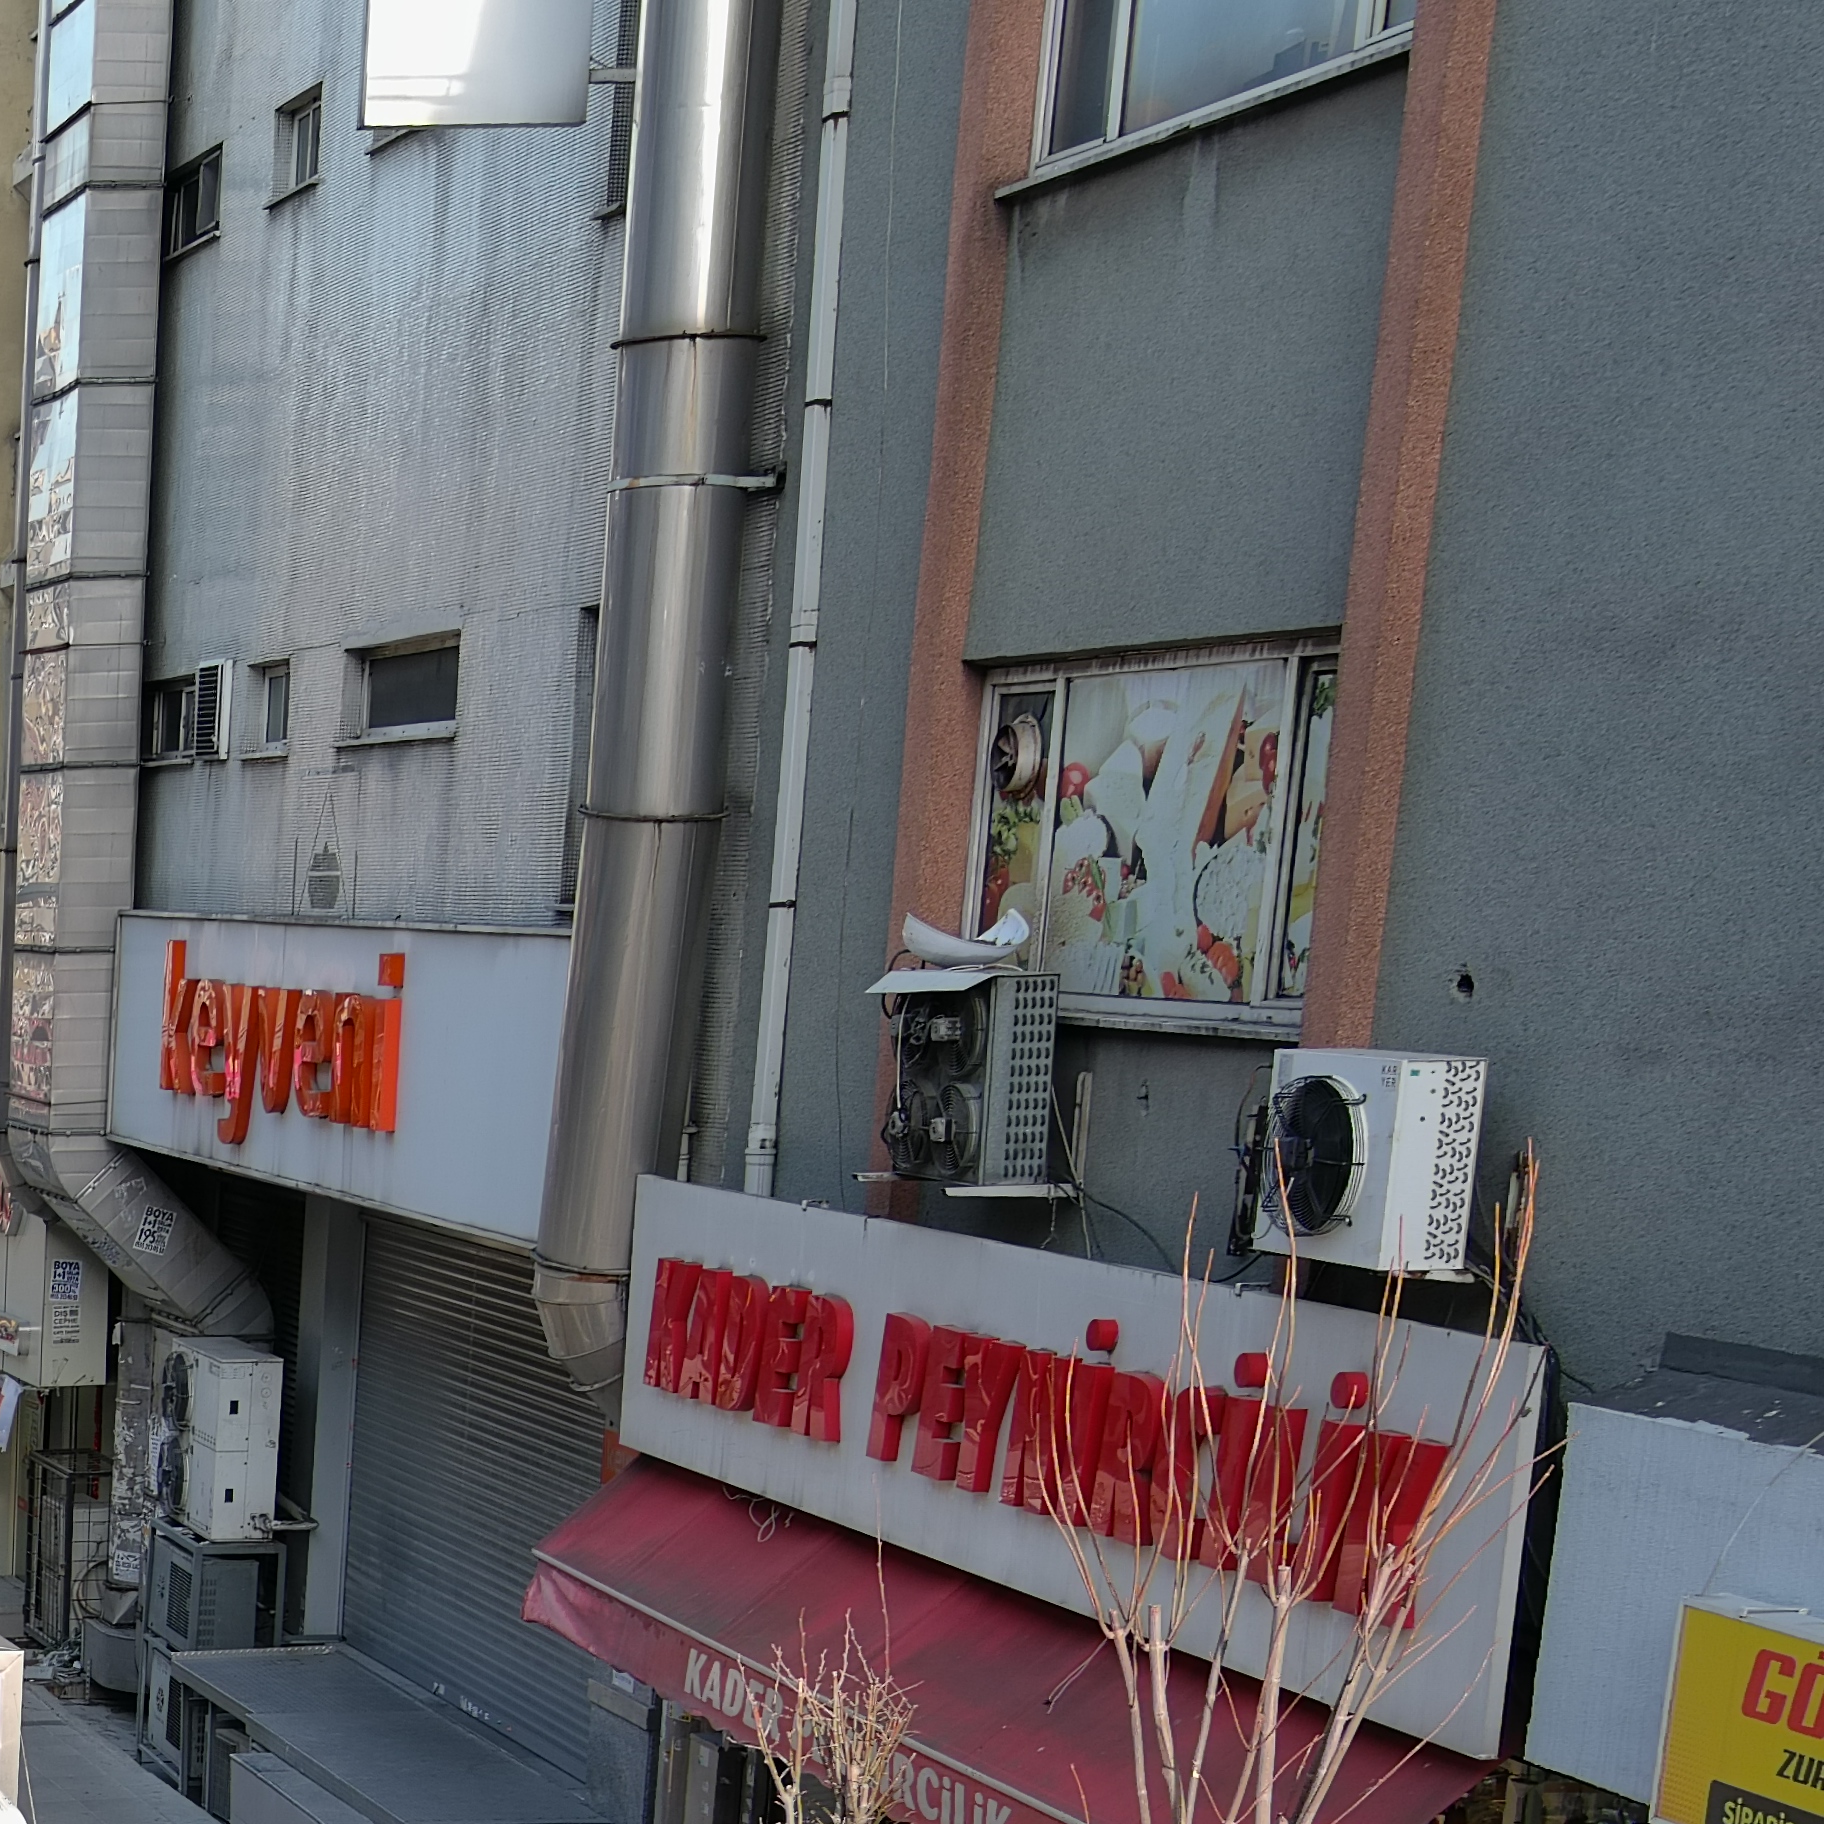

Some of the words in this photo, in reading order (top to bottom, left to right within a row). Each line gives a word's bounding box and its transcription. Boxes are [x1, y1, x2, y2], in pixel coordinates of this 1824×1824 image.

[141, 1216, 158, 1229] 1+1
[145, 1206, 174, 1223] BOYA
[138, 1227, 158, 1244] 195
[53, 1260, 80, 1271] BOYA
[641, 1255, 855, 1445] KADER
[683, 1647, 785, 1741] KADER
